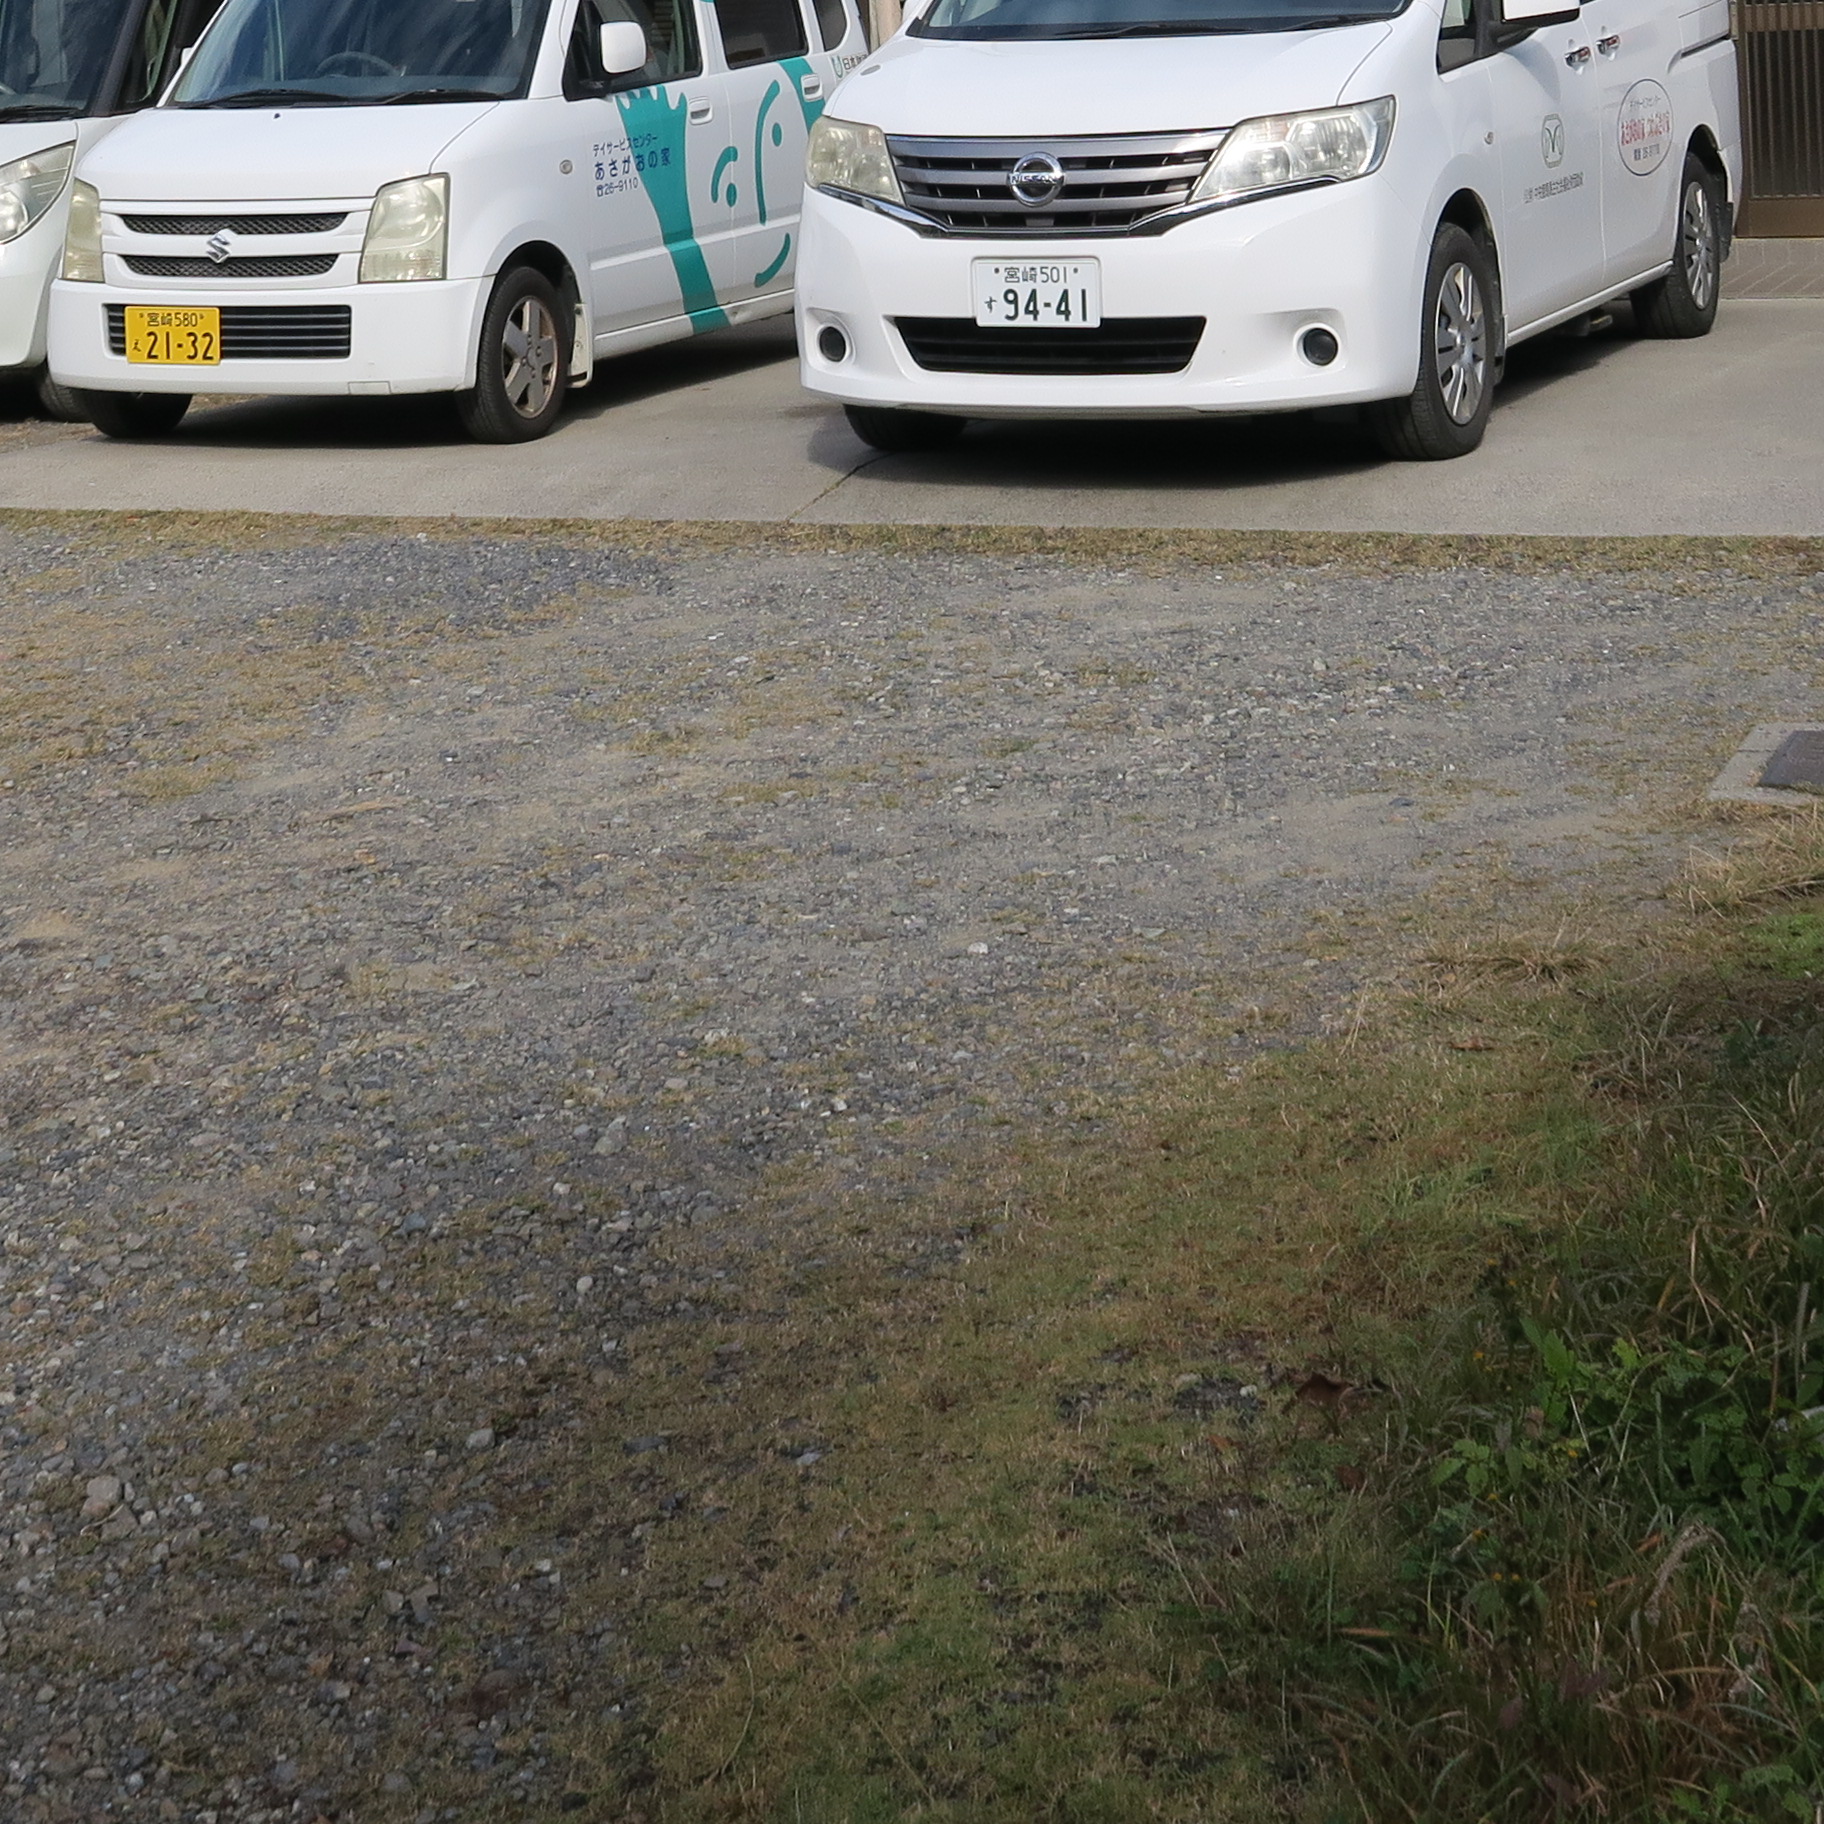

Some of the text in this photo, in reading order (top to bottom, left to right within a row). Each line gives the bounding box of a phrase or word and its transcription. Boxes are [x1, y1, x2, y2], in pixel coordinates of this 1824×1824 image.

[594, 147, 670, 180] あさがおの家
[1003, 288, 1087, 322] 94-41
[146, 331, 214, 360] 21-32
